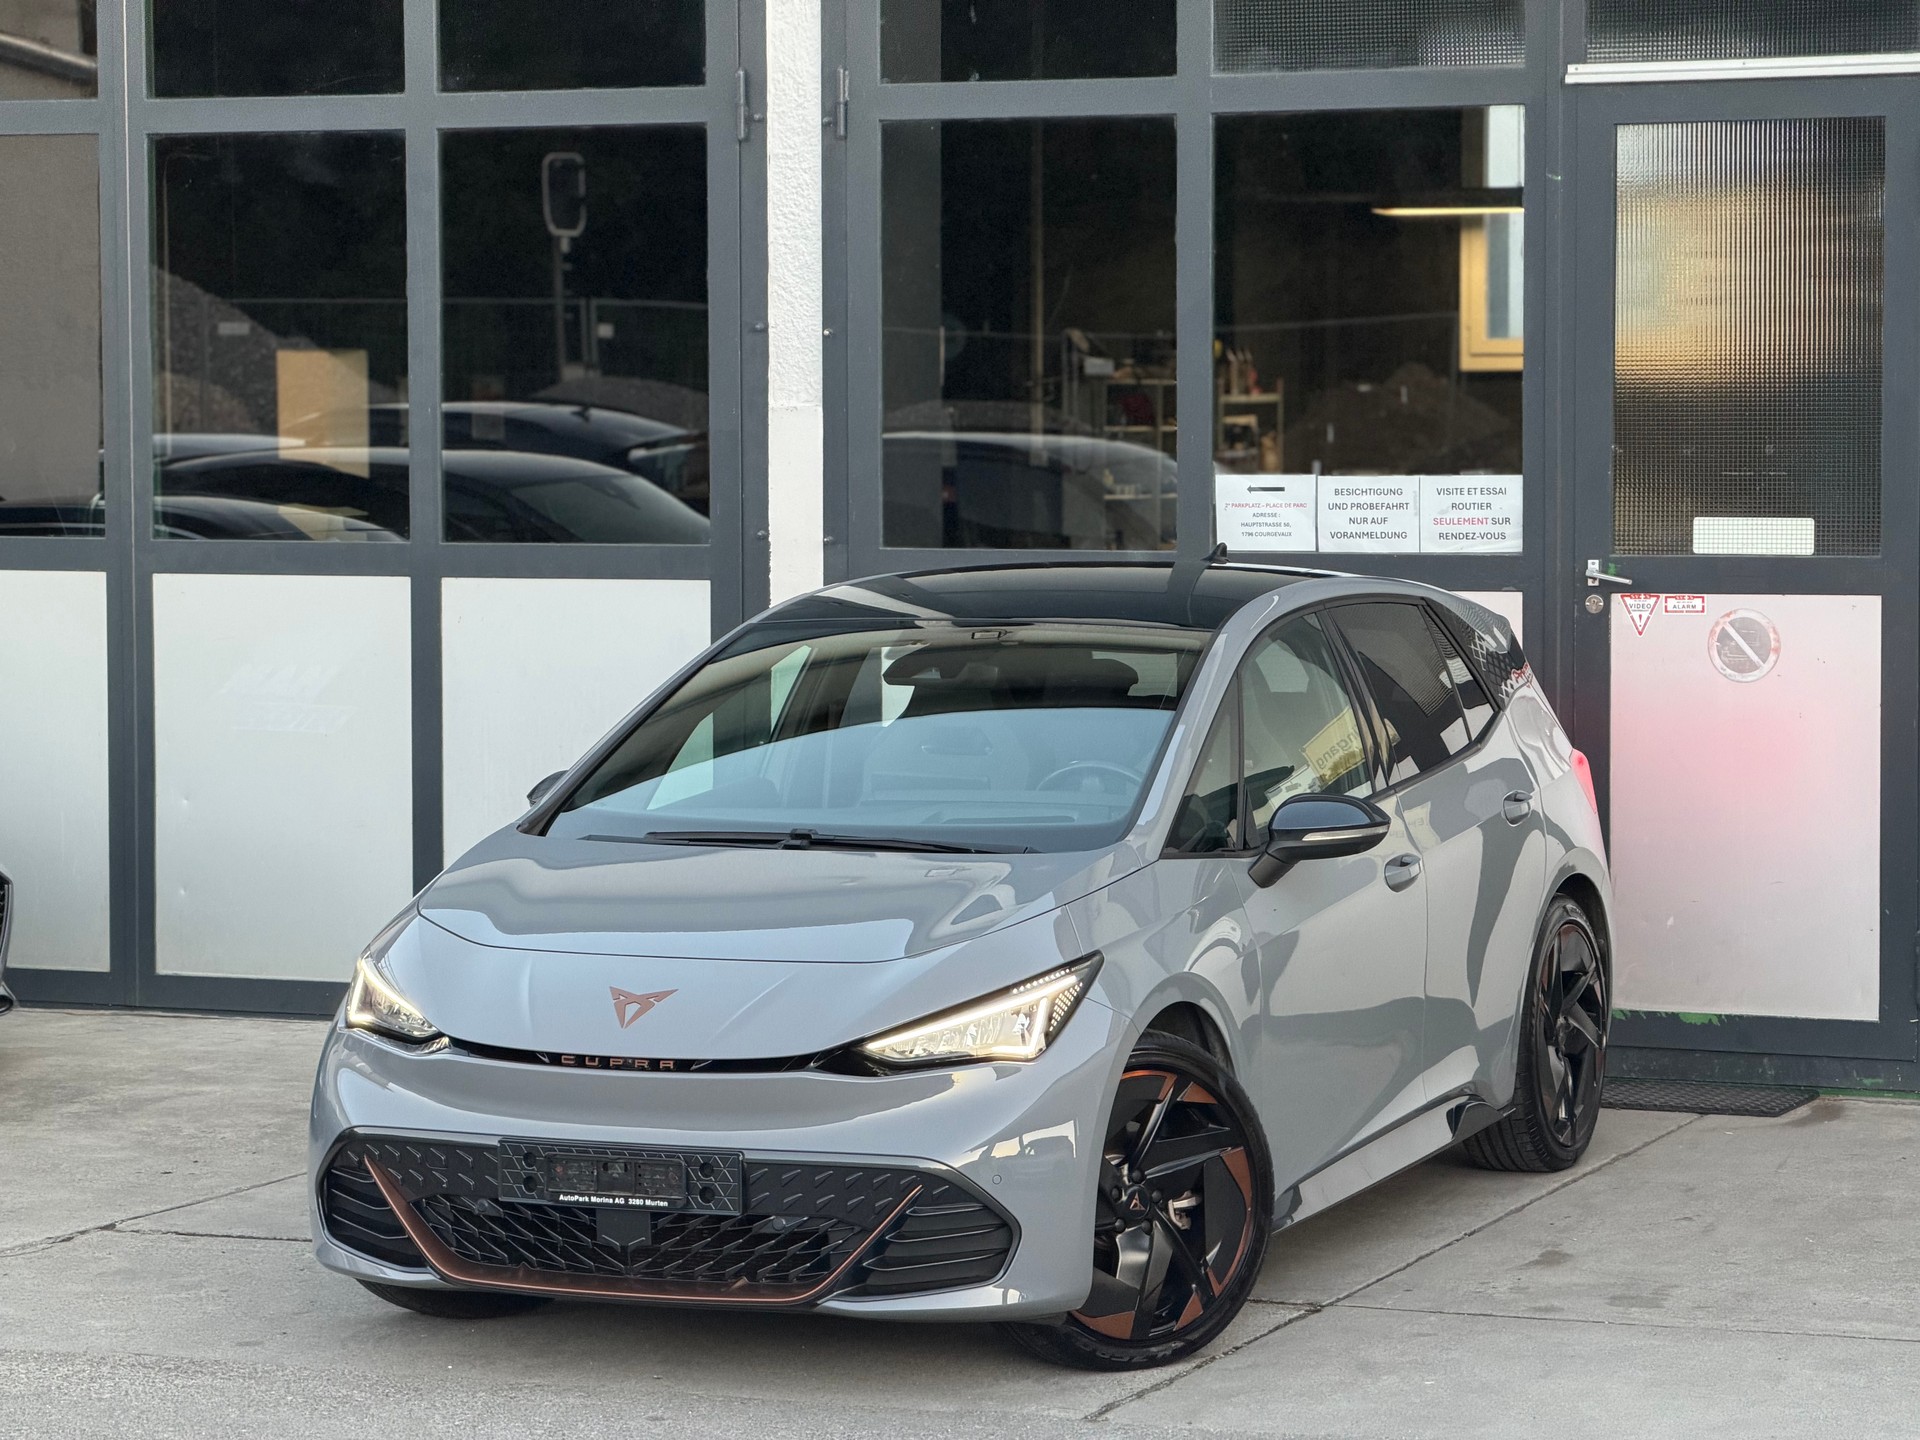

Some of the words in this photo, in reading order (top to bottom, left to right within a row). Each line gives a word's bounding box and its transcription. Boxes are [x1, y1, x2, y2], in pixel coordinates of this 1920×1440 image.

[1334, 487, 1403, 496] BESICHTIGUNG
[1436, 487, 1465, 496] VISITE
[1467, 487, 1478, 496] ET
[1479, 487, 1506, 496] ESSAI
[1328, 502, 1348, 511] UND
[1350, 502, 1410, 511] PROBEFAHRT
[1451, 502, 1492, 511] ROUTIER
[1348, 516, 1368, 525] NUR
[1370, 516, 1389, 525] AUF
[1433, 517, 1489, 526] SEULEMENT
[1491, 517, 1511, 526] SUR
[1329, 531, 1407, 540] VORANMELDUNG
[1438, 531, 1507, 541] RENDEZ-VOUS
[561, 1055, 675, 1069] CUPRA
[558, 1194, 590, 1202] AutoPark
[590, 1196, 613, 1204] Morina
[628, 1198, 644, 1206] 3280
[644, 1199, 668, 1207] Murten
